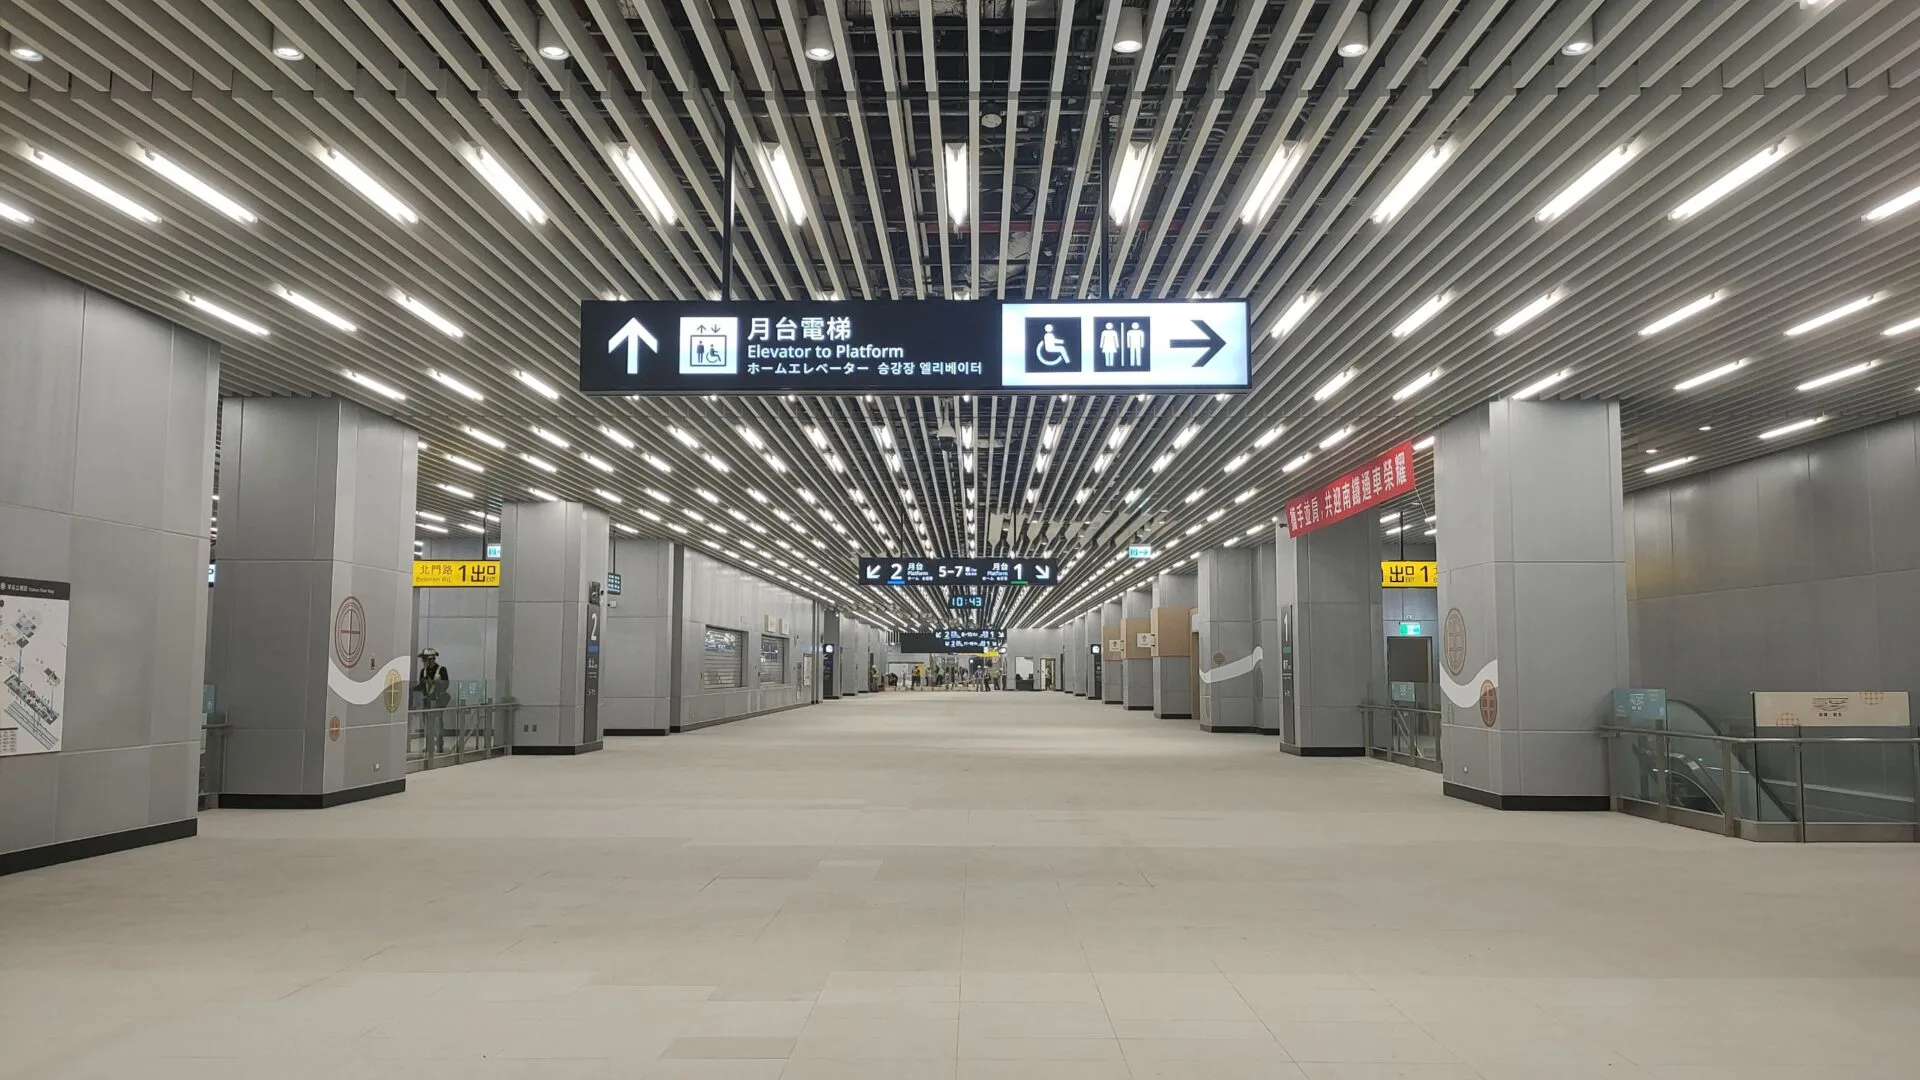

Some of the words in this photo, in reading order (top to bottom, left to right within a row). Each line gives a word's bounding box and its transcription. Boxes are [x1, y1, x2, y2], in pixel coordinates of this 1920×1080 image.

[747, 316, 852, 341] 月台電梯
[747, 344, 811, 359] Elevator
[815, 346, 831, 359] to
[836, 344, 904, 359] Platform
[747, 362, 869, 375] ホームエレベーター
[877, 361, 915, 375] 승강장
[919, 361, 982, 375] 엘리베이터
[419, 564, 453, 575] 北門路
[458, 564, 467, 582] 1
[471, 564, 496, 583] 出口
[890, 563, 903, 580] 2
[907, 562, 924, 571] 月台
[938, 565, 964, 577] 5-7
[992, 562, 1009, 571] 月台
[1013, 563, 1022, 580] 1
[1389, 565, 1415, 583] 出口
[1420, 565, 1429, 583] 1
[951, 597, 982, 607] 10:43
[590, 613, 598, 641] 2
[1283, 614, 1289, 642] 1
